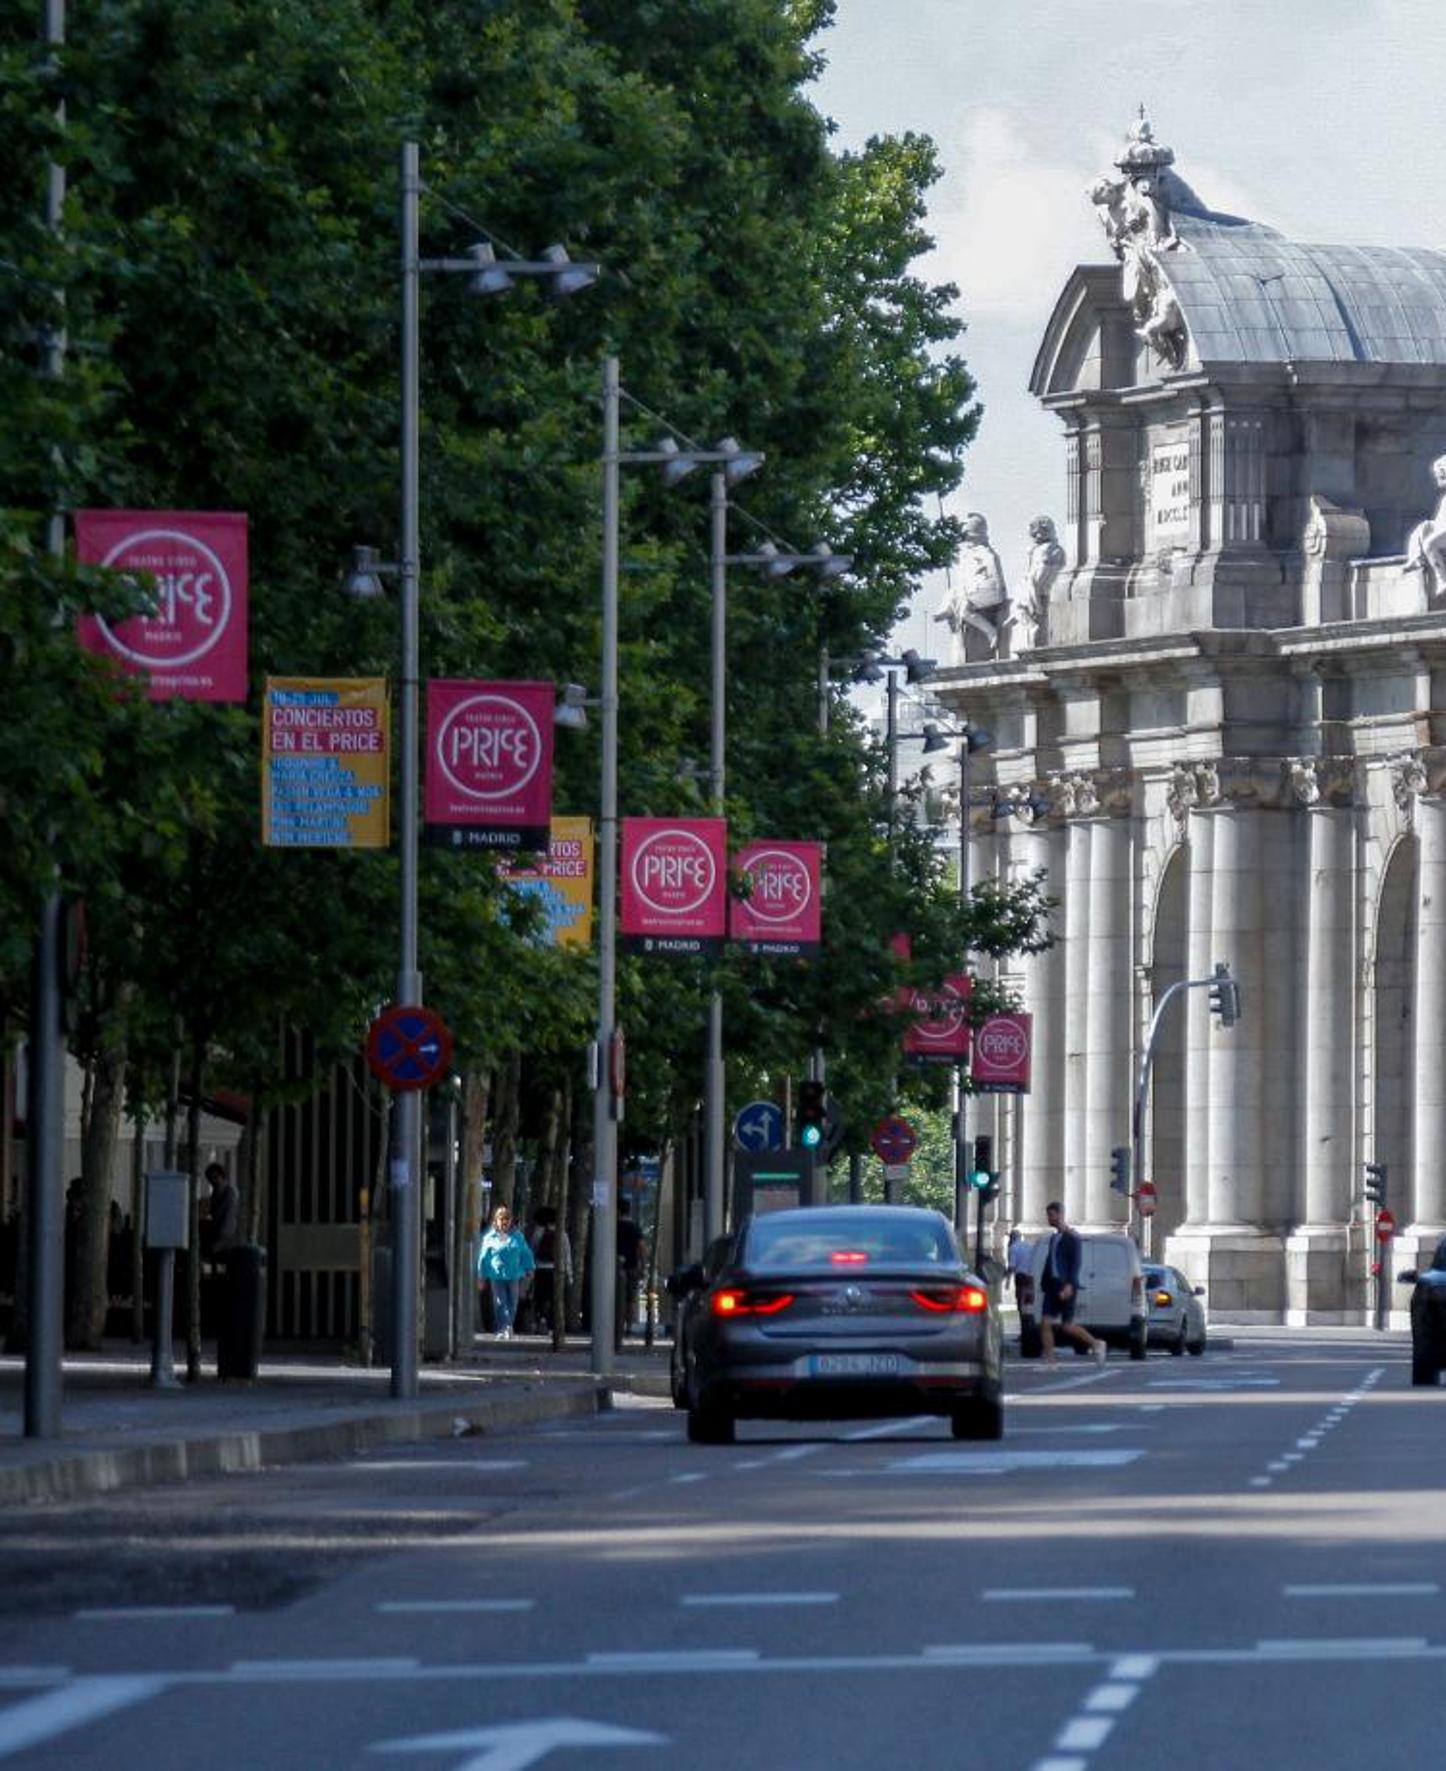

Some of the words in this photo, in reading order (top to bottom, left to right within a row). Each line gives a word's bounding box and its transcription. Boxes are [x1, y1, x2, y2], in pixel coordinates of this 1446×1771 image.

[272, 708, 375, 728] CONCIERTOS
[272, 732, 296, 751] EN
[302, 732, 323, 751] EL
[329, 732, 380, 751] PRICE
[451, 726, 528, 768] PRICE
[469, 831, 522, 845] MADRID
[644, 854, 706, 889] PRICE
[658, 939, 702, 952] MADRID
